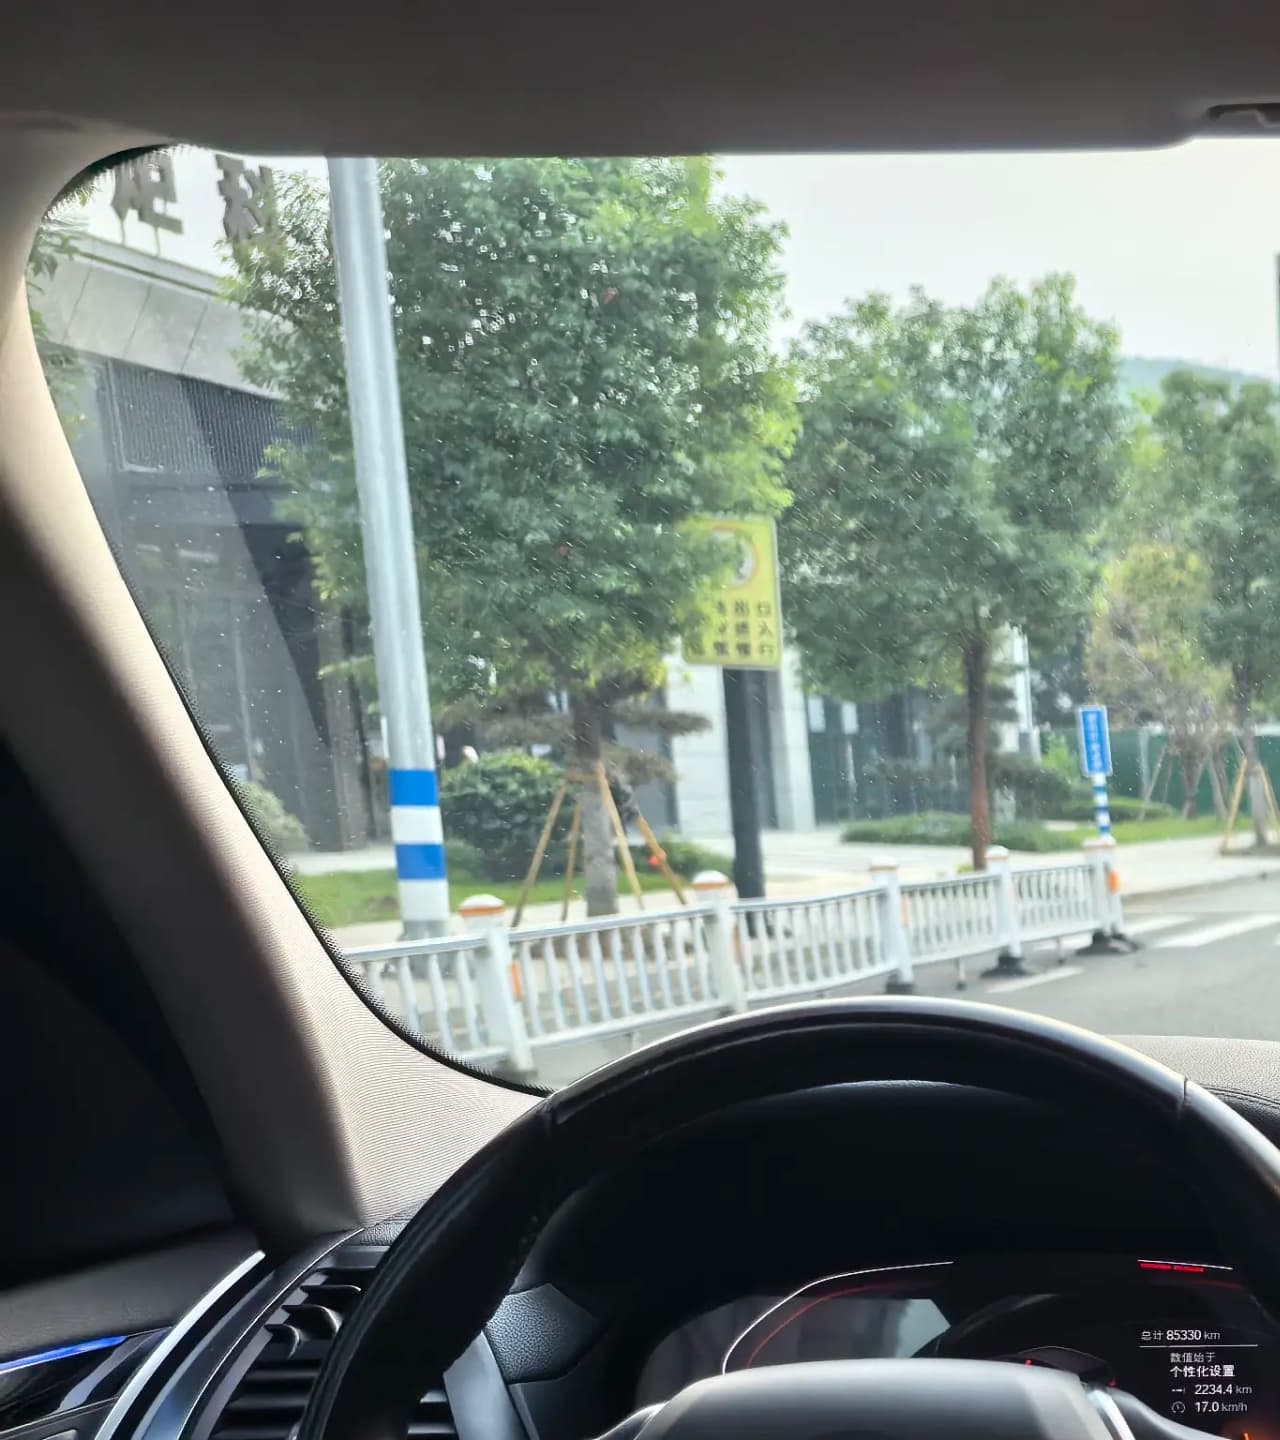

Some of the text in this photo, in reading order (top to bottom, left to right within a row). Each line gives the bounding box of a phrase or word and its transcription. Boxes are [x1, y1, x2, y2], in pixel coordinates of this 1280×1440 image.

[1141, 1329, 1221, 1341] 总计 85330 km
[1169, 1364, 1236, 1378] 个性化设置
[1194, 1384, 1253, 1395] 2234.4 km
[1194, 1401, 1248, 1413] 17.0 km/h
